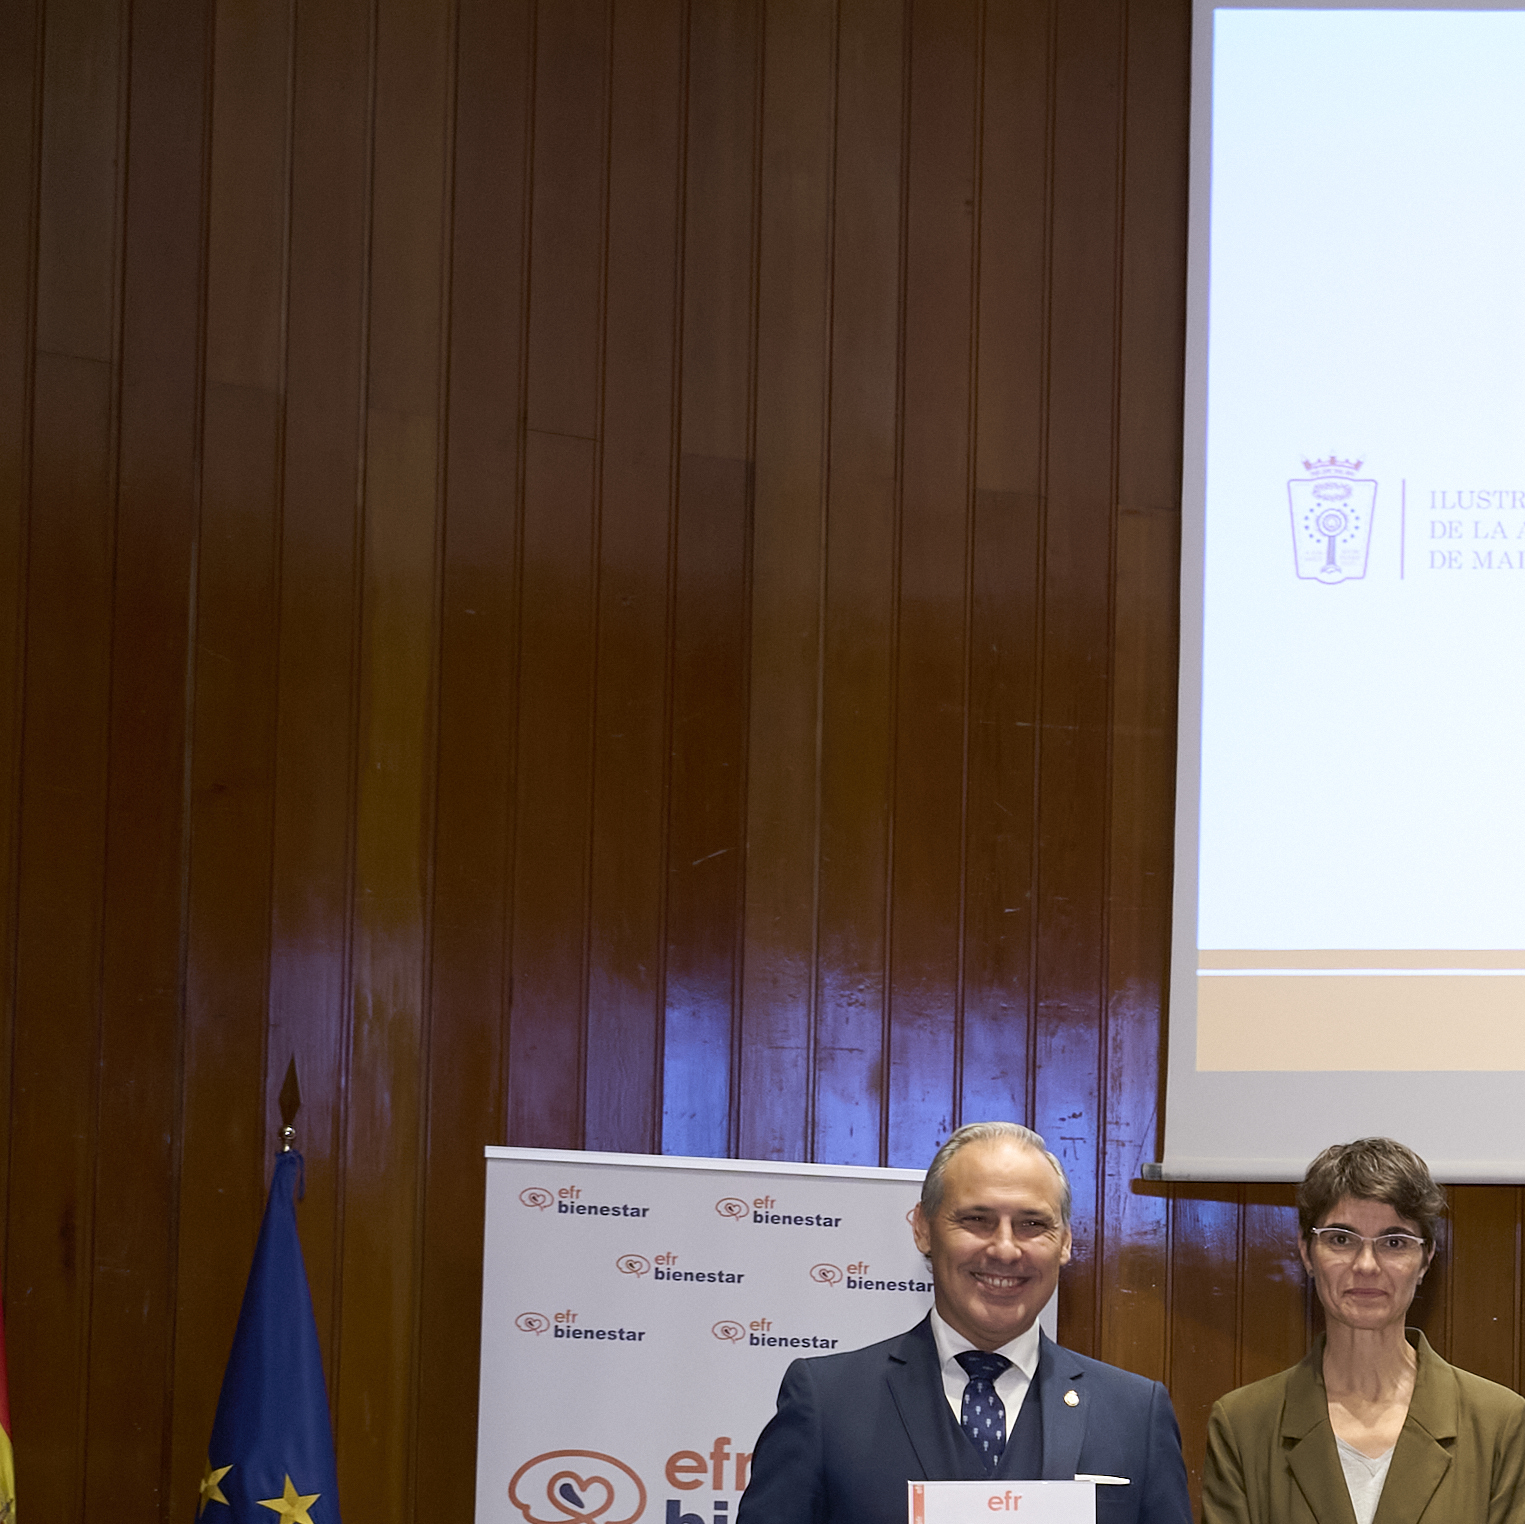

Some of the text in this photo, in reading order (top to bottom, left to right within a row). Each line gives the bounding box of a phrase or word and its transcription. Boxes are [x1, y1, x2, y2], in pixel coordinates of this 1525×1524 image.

[1430, 520, 1463, 539] DE
[1474, 521, 1508, 539] LA
[1429, 550, 1463, 570] DE
[558, 1185, 582, 1199] efr
[558, 1200, 649, 1217] bienestar
[753, 1195, 776, 1209] efr
[753, 1210, 842, 1227] bienestar
[654, 1251, 678, 1265] efr
[654, 1267, 744, 1283] bienestar
[847, 1261, 869, 1274] efr
[846, 1276, 934, 1292] bienestar
[554, 1309, 578, 1323] efr
[554, 1324, 645, 1341] bienestar
[749, 1318, 772, 1331] efr
[749, 1333, 838, 1349] bienestar
[665, 1436, 754, 1491] efr
[988, 1490, 1022, 1511] efr
